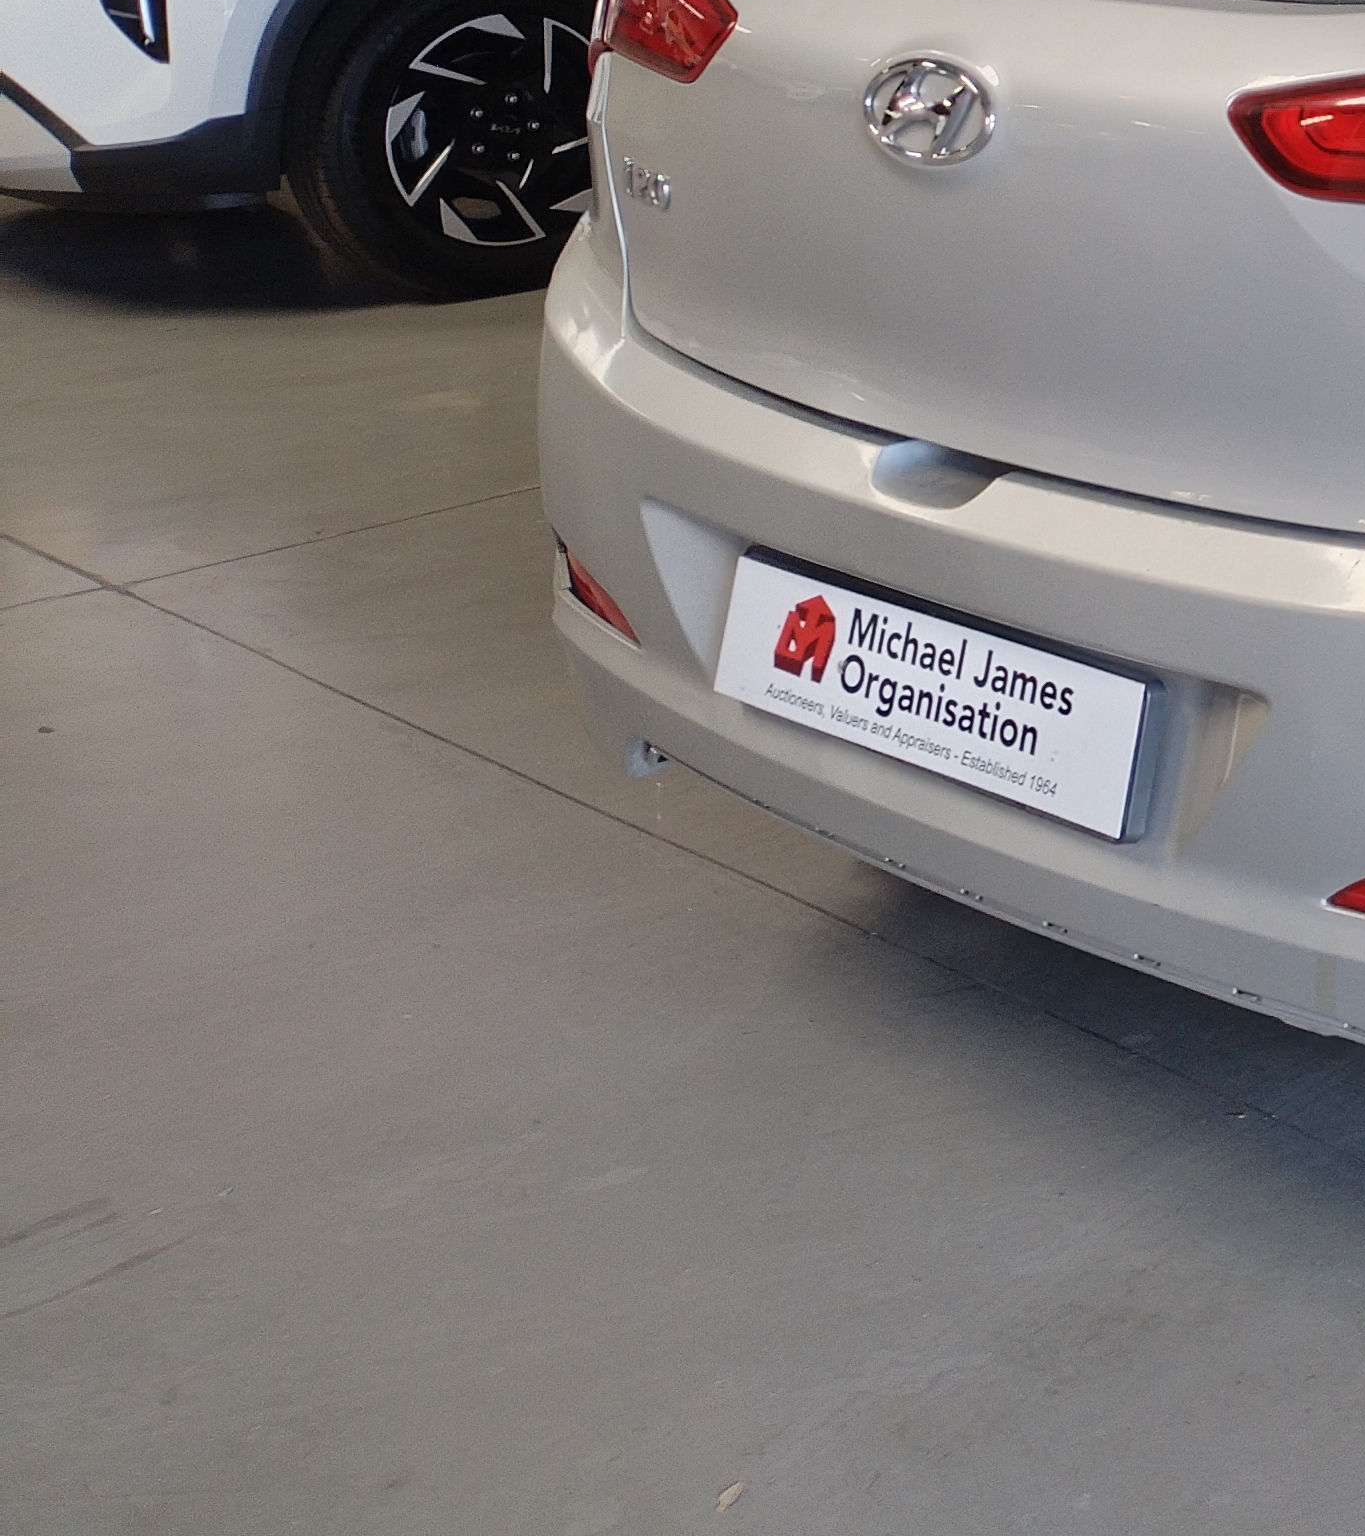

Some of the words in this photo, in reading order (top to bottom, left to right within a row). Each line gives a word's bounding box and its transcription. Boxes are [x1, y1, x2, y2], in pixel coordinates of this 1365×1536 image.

[839, 654, 1039, 756] Organisation
[847, 607, 968, 680] Michael
[973, 649, 1075, 715] James
[764, 683, 826, 719] Auctioneers,
[830, 704, 869, 732] Valuers
[870, 722, 893, 739] and
[892, 727, 952, 761] Appraisers
[960, 750, 1027, 786] Established
[1029, 775, 1058, 798] 1964
